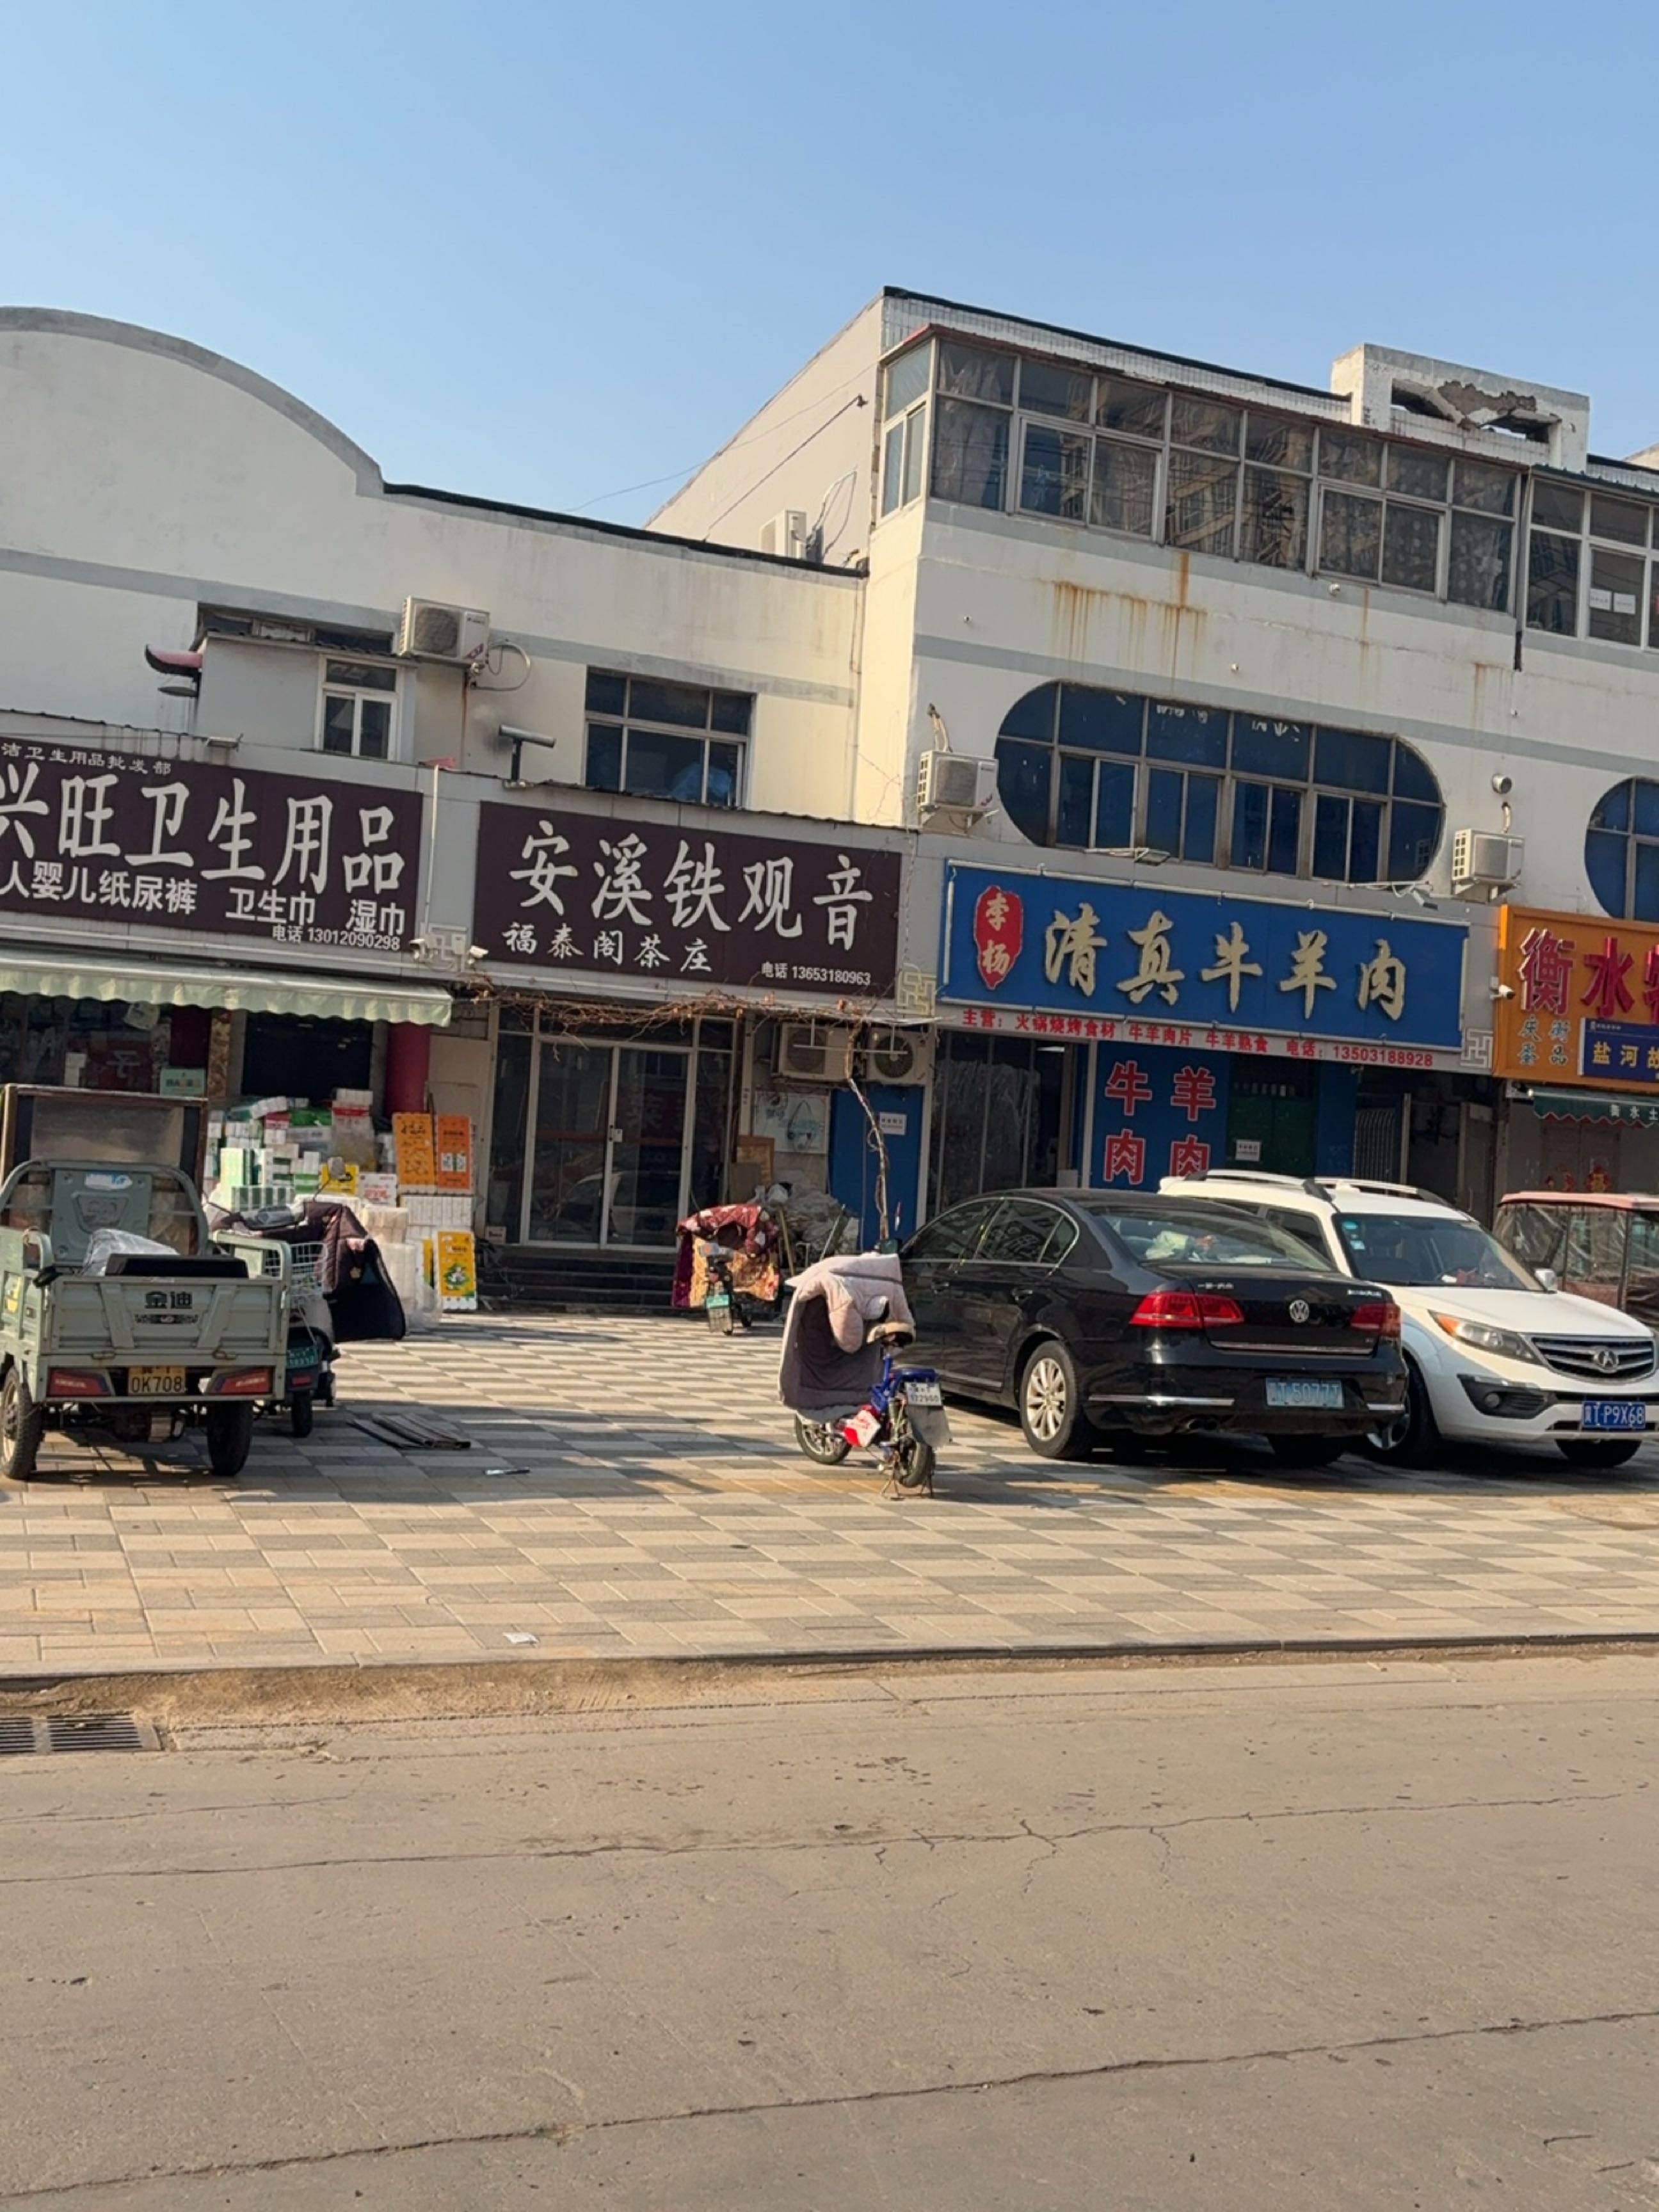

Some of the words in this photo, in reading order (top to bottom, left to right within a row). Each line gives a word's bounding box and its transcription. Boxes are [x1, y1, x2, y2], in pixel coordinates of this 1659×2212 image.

[0, 761, 405, 895] 兴旺卫生用品
[0, 860, 198, 915] 人婴儿纸尿裤
[225, 886, 316, 926] 卫生巾
[346, 899, 406, 936] 湿巾
[509, 819, 874, 951] 安溪铁观音
[272, 924, 303, 944] 电话
[307, 926, 401, 951] 13012090298
[502, 921, 713, 973] 福泰阁茶庄
[1045, 902, 1407, 1021] 清真牛羊肉
[762, 961, 789, 979] 电话
[792, 966, 871, 986] 13653180963
[1015, 1013, 1116, 1039] 火锅烧烤食材
[1128, 1023, 1192, 1046] 牛羊肉片
[1206, 1031, 1269, 1053] 牛羊熟食
[1333, 1045, 1434, 1068] 13503188928
